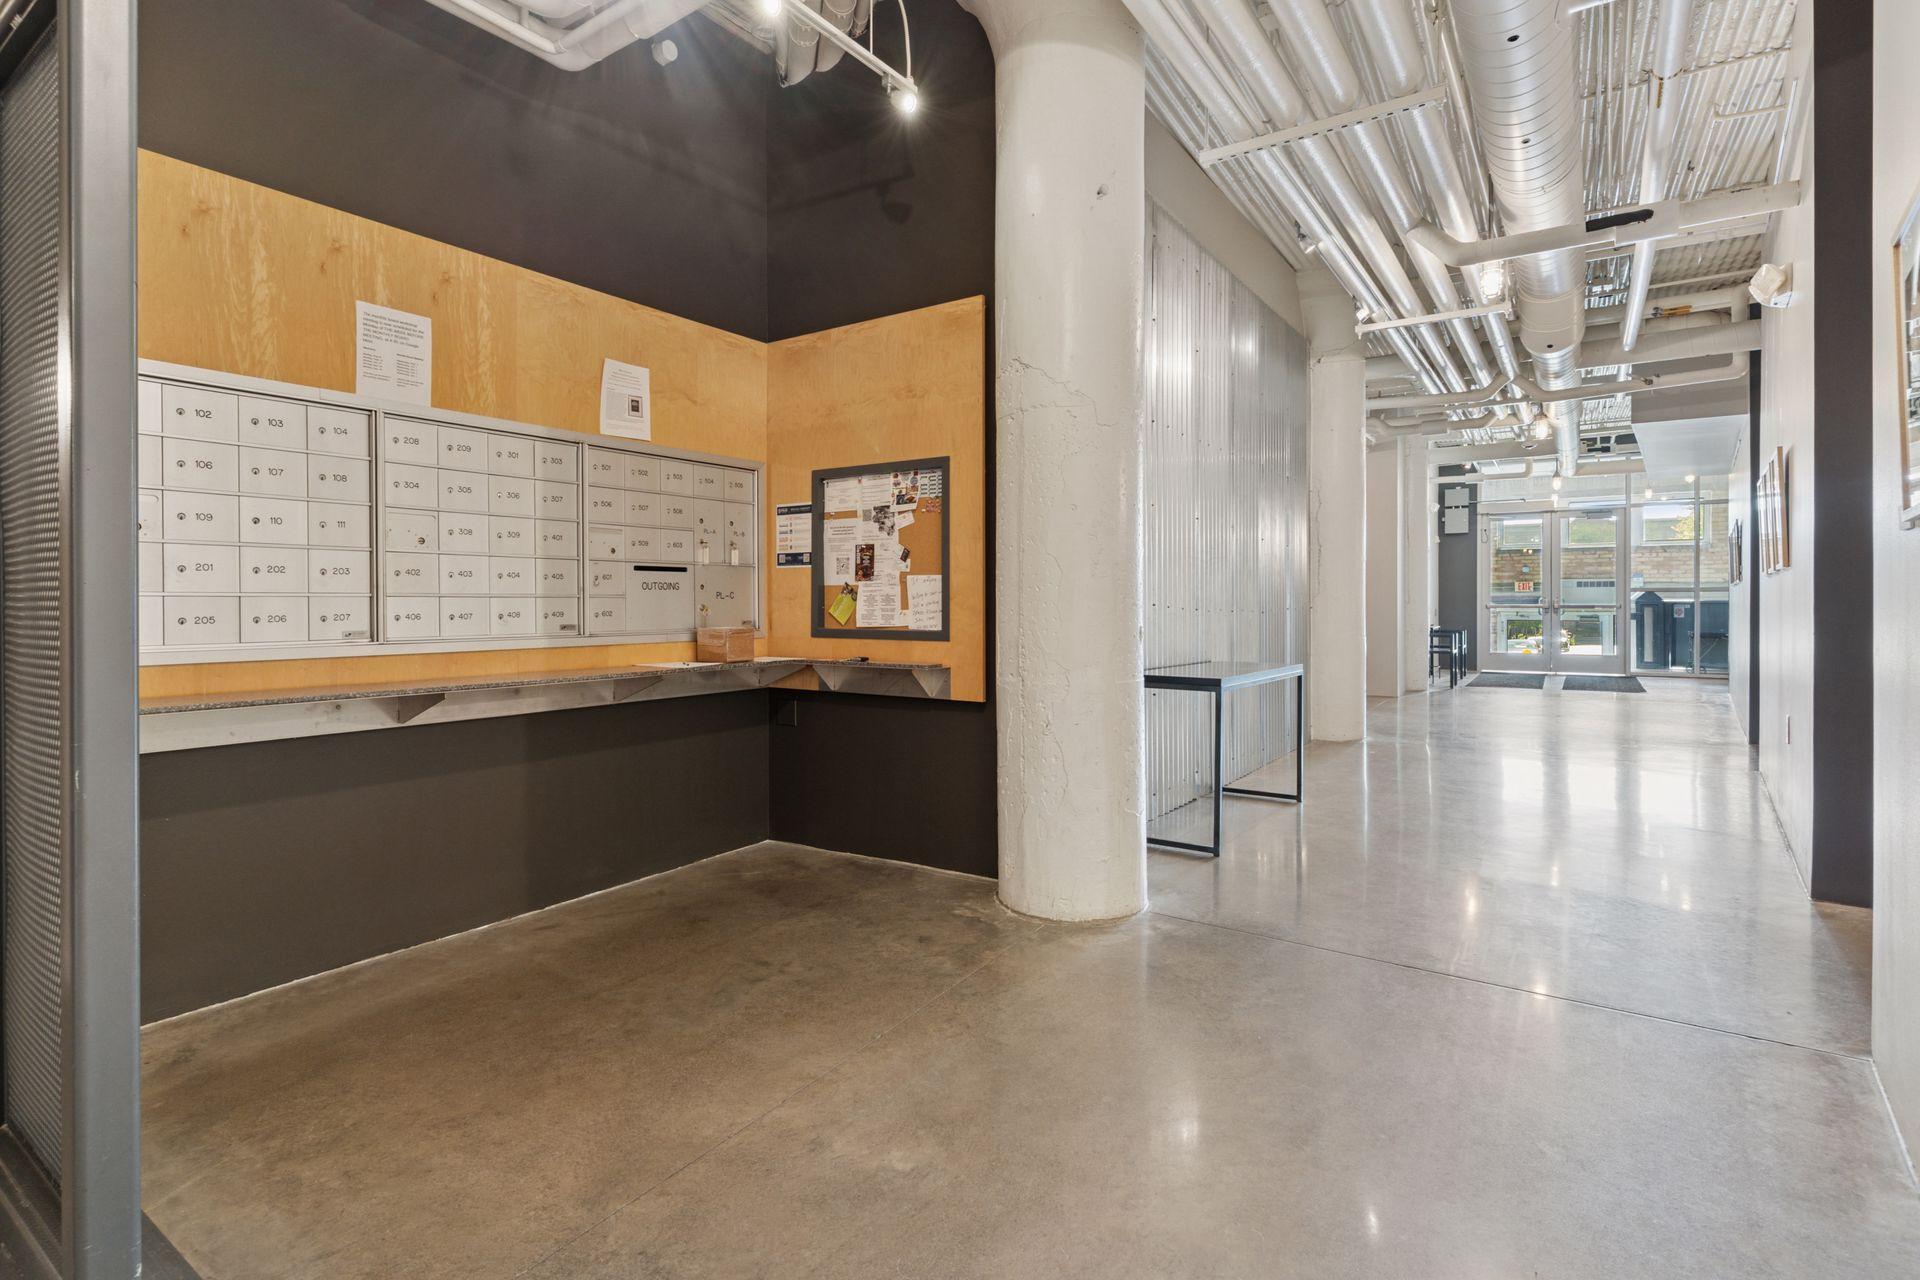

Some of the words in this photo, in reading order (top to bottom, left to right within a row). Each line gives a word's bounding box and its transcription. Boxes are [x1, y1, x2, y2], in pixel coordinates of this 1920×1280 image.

[194, 408, 213, 419] 102
[267, 418, 284, 428] 103
[333, 426, 348, 435] 104
[403, 436, 420, 446] 208
[456, 444, 472, 453] 209
[507, 451, 519, 460] 301
[195, 459, 213, 470] 106
[268, 467, 285, 477] 107
[637, 469, 649, 477] 502
[332, 473, 348, 483] 108
[403, 480, 420, 489] 304
[506, 491, 521, 500] 306
[550, 495, 564, 503] 307
[638, 504, 649, 512] 507
[195, 512, 214, 522] 109
[269, 516, 283, 526] 110
[337, 520, 346, 529] 111
[458, 528, 473, 536] 308
[506, 530, 521, 539] 309
[551, 534, 563, 542] 401
[195, 562, 214, 572] 201
[266, 564, 286, 574] 202
[332, 567, 351, 576] 203
[404, 568, 421, 577] 402
[457, 570, 473, 578] 403
[506, 571, 521, 579] 404
[641, 581, 680, 591] OUTGOING
[715, 591, 735, 600] PL-C
[194, 615, 216, 625] 205
[267, 614, 287, 623] 206
[332, 613, 351, 622] 207
[404, 612, 422, 621] 406
[458, 612, 473, 621] 407
